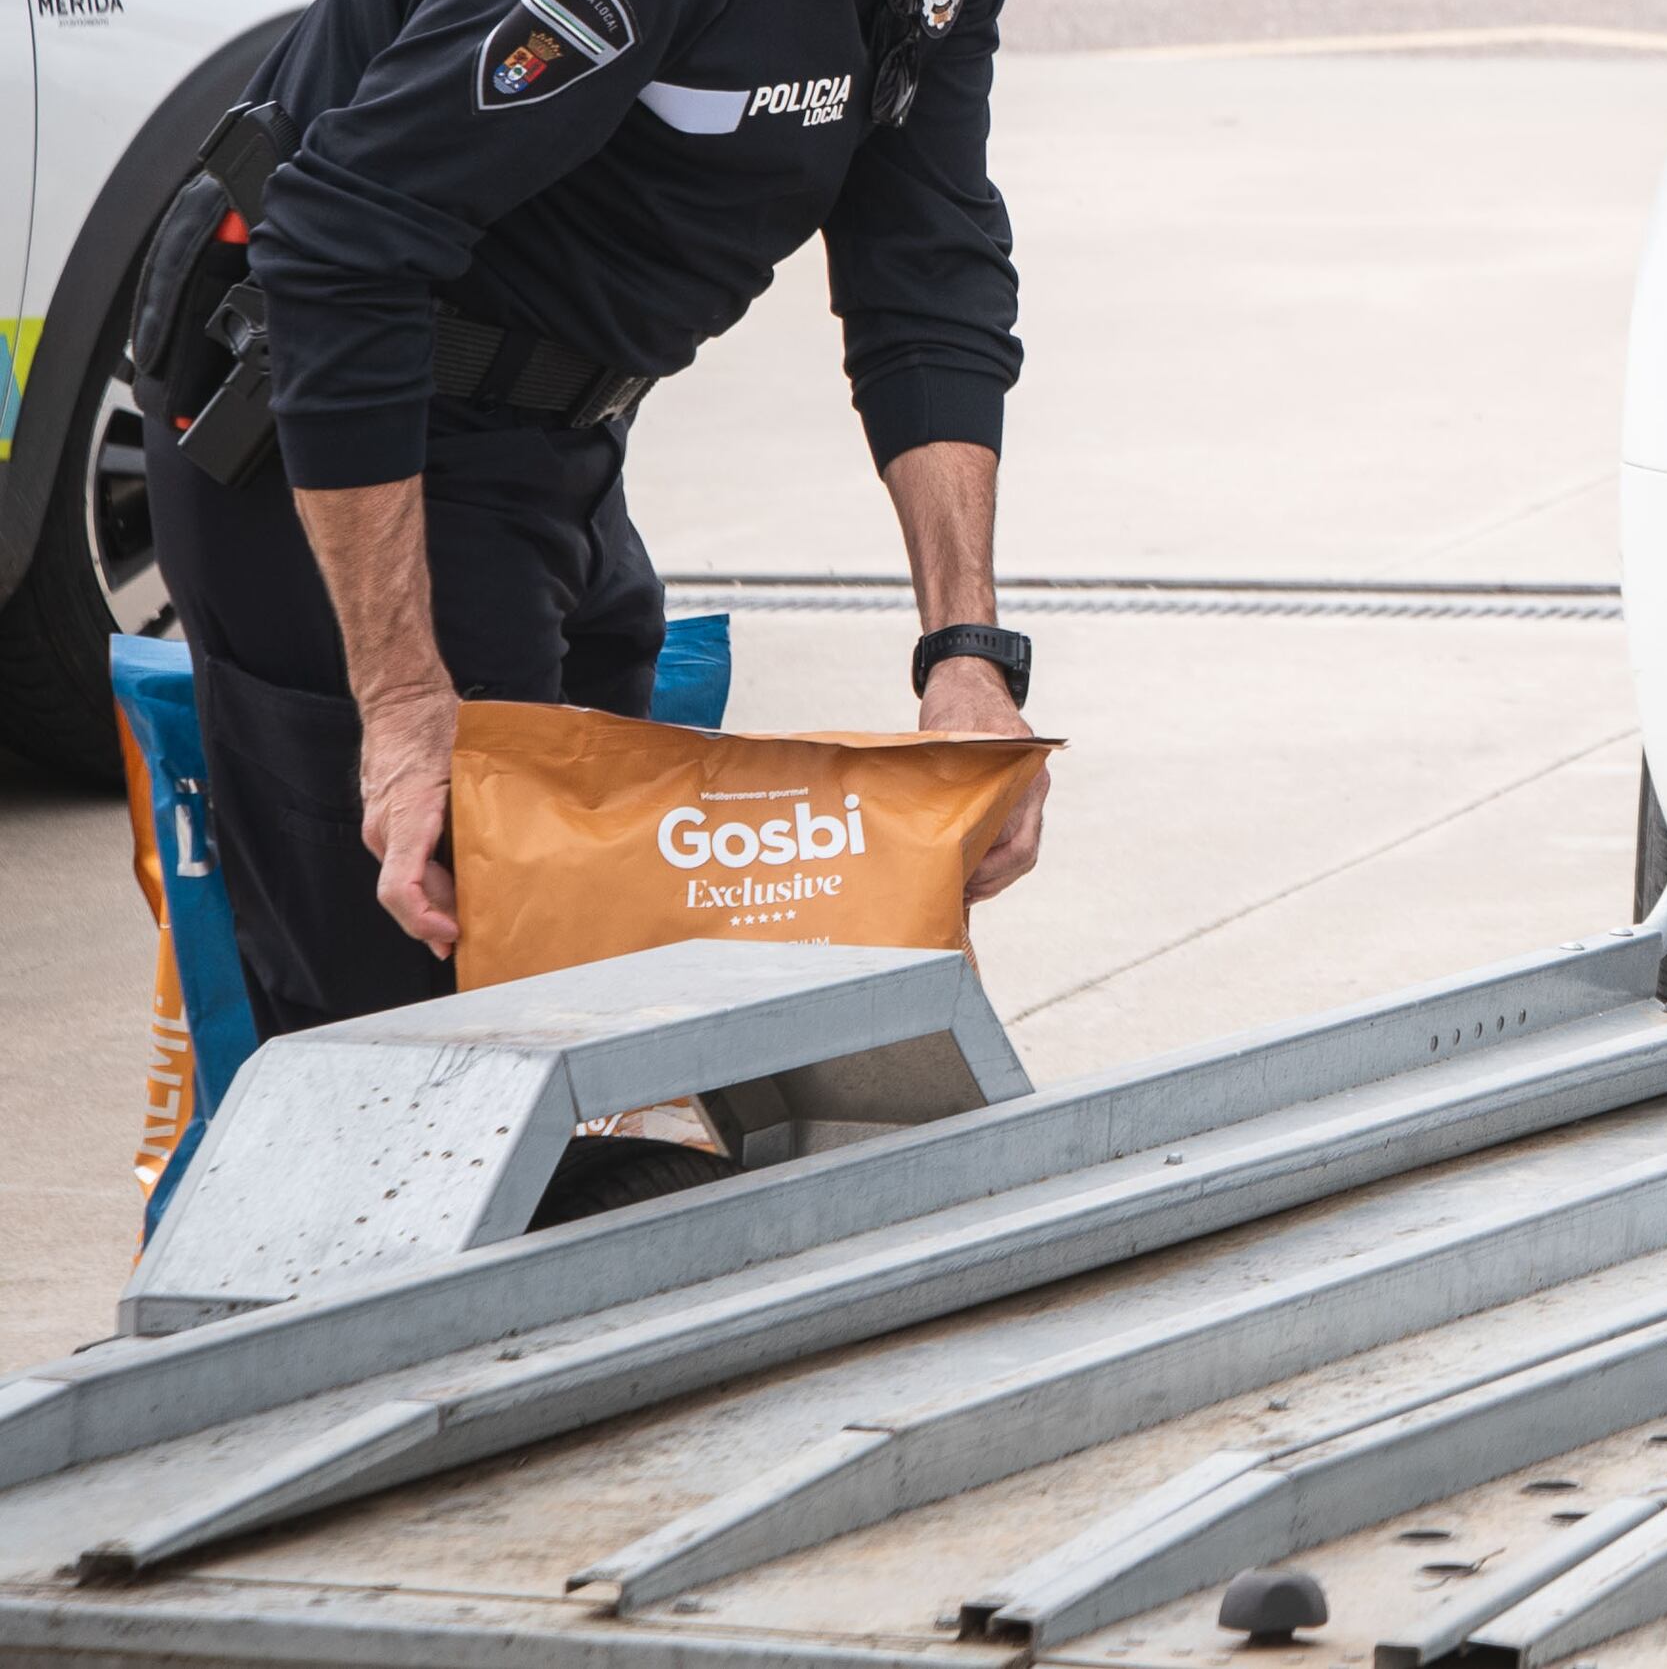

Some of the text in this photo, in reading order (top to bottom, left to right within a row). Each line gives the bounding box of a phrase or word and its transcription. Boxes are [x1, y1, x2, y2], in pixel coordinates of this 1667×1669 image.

[594, 0, 619, 33] LOCAL
[749, 75, 851, 116] POLICIA
[802, 104, 845, 127] LOCAL
[768, 787, 809, 800] gourmet
[657, 793, 866, 869] Gosbi
[686, 872, 842, 908] Exclusive
